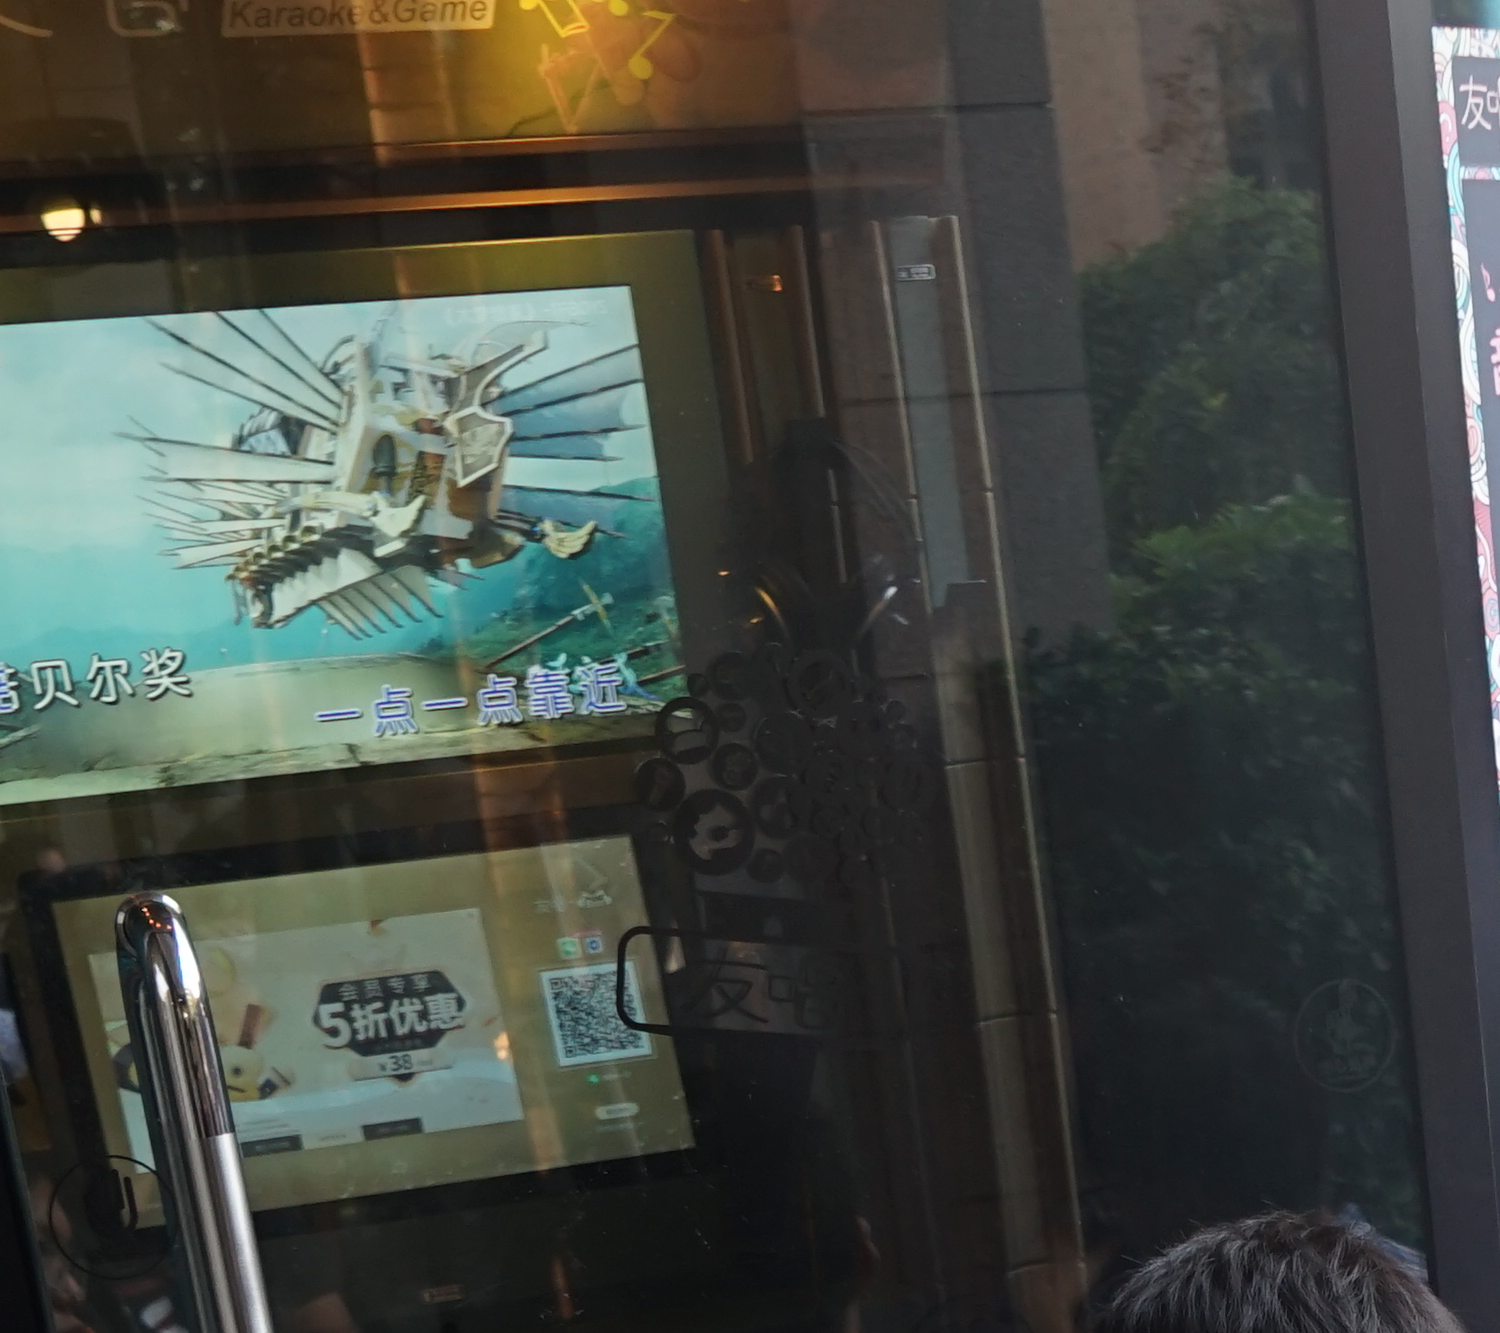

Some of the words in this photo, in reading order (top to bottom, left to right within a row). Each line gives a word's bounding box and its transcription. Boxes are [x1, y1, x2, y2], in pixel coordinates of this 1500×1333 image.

[228, 0, 491, 29] Karaoke&Game
[315, 661, 629, 739] 一点一点靠近
[316, 991, 465, 1049] 5折优惠
